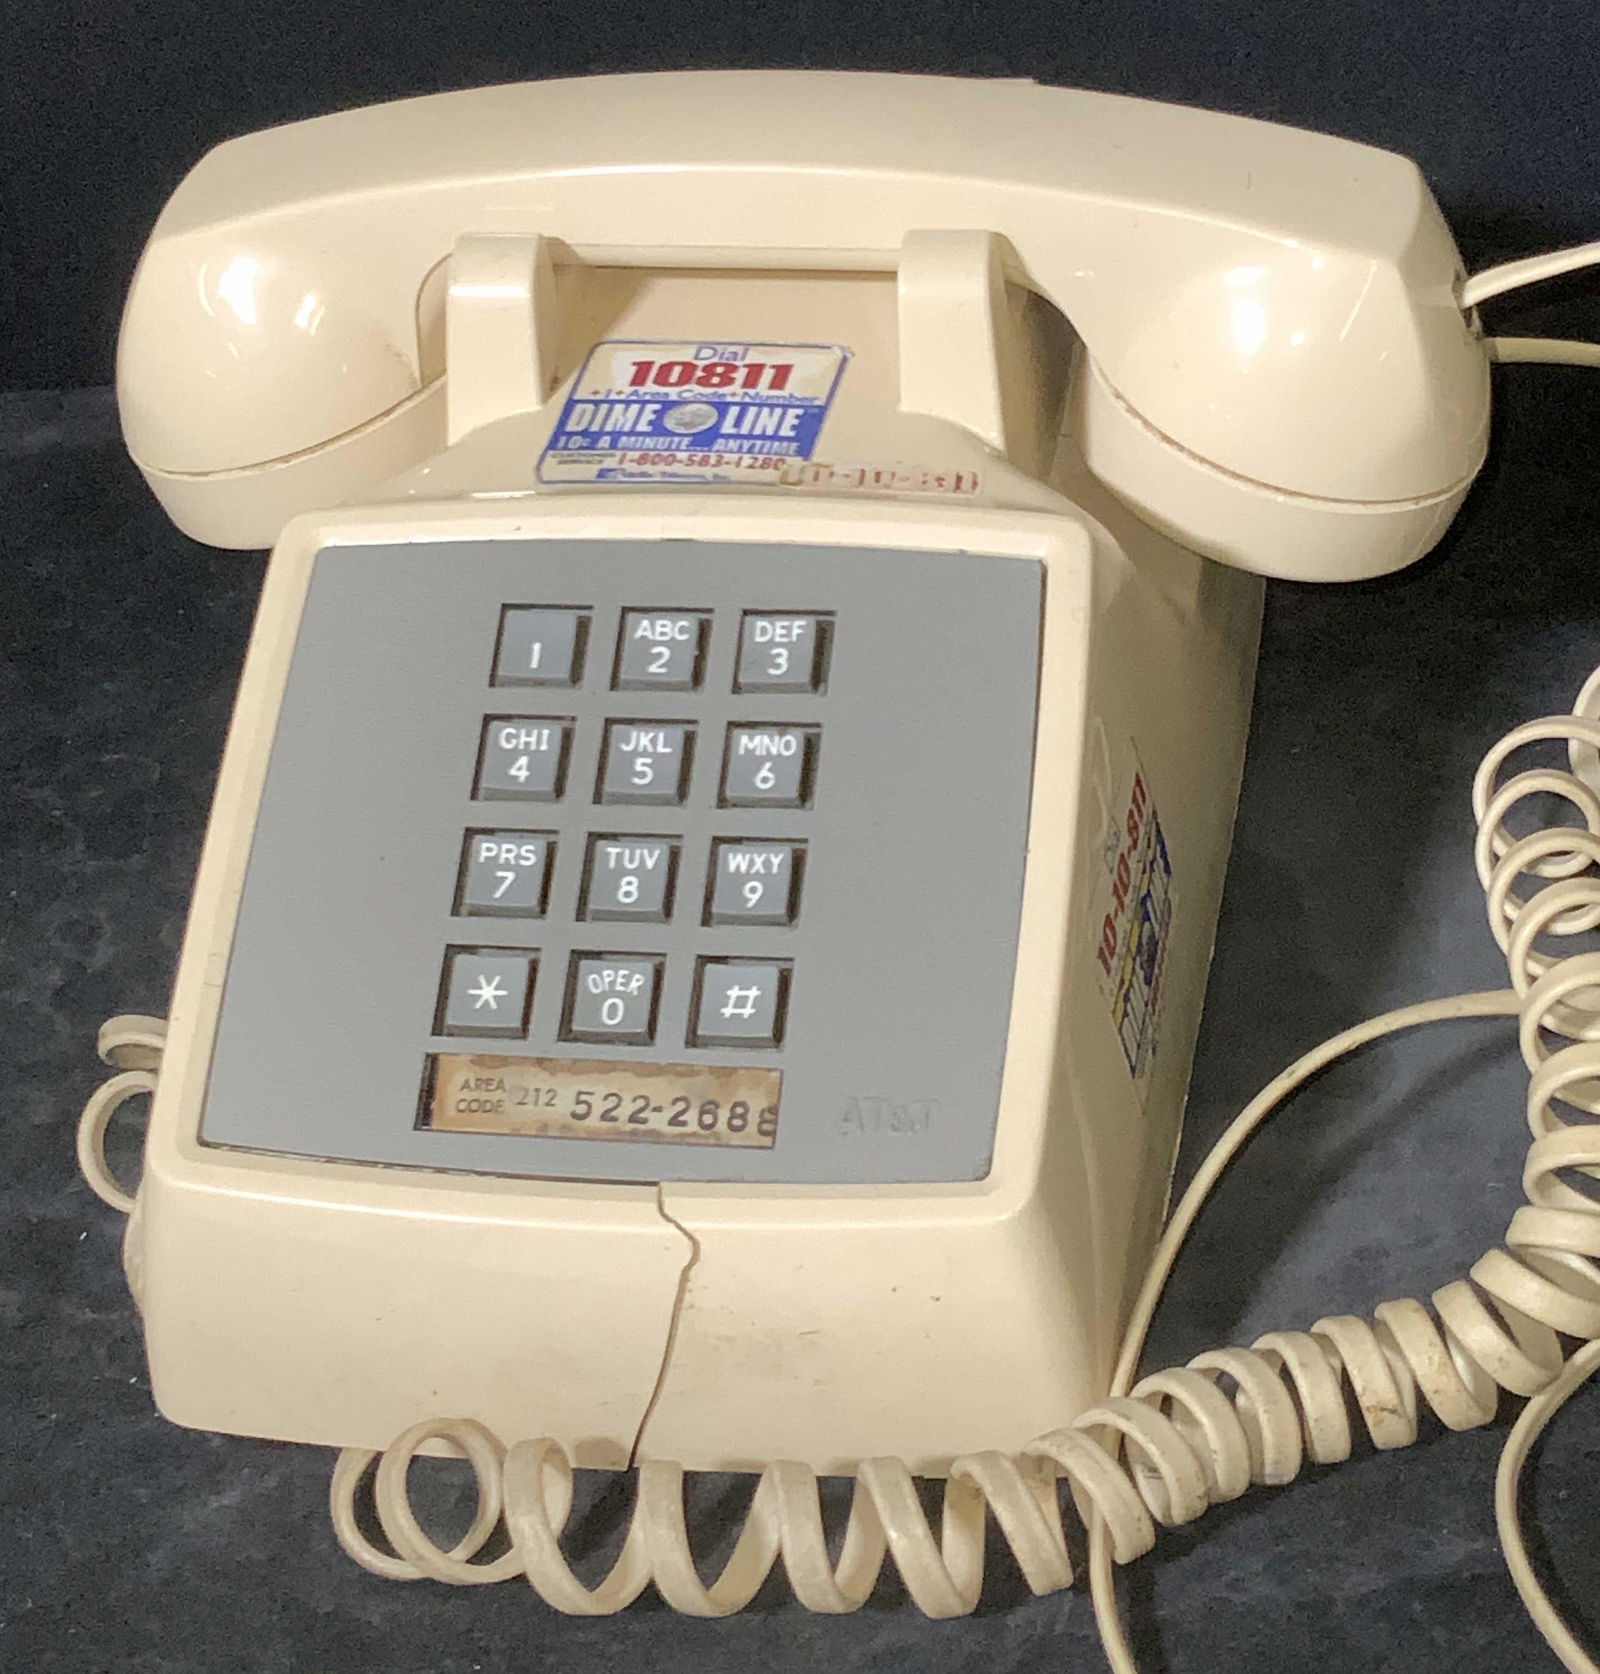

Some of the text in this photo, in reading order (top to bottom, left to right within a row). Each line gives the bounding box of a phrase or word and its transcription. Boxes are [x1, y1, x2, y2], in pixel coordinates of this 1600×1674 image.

[693, 345, 748, 362] Dial
[629, 361, 794, 391] 10811
[563, 402, 805, 438] DIME LINE
[595, 437, 612, 451] A
[711, 439, 800, 456] ANYTIME
[634, 619, 690, 642] ABC
[754, 620, 807, 643] DEF
[530, 642, 542, 669] 1
[648, 645, 671, 673] 2
[767, 647, 789, 675] 3
[500, 727, 550, 751] GHI
[620, 731, 673, 754] JKL
[738, 734, 797, 756] MNO
[509, 755, 530, 783] 4
[632, 757, 654, 785] 5
[755, 761, 775, 790] 6
[479, 842, 537, 866] PRS
[606, 847, 661, 870] TUV
[727, 852, 784, 875] WXY
[493, 870, 516, 899] 7
[617, 875, 639, 904] 8
[742, 880, 763, 908] 9
[587, 969, 645, 997] OPER
[601, 997, 624, 1026] 0
[460, 1078, 506, 1092] AREA
[456, 1098, 504, 1113] CODE
[515, 1086, 558, 1107] 212
